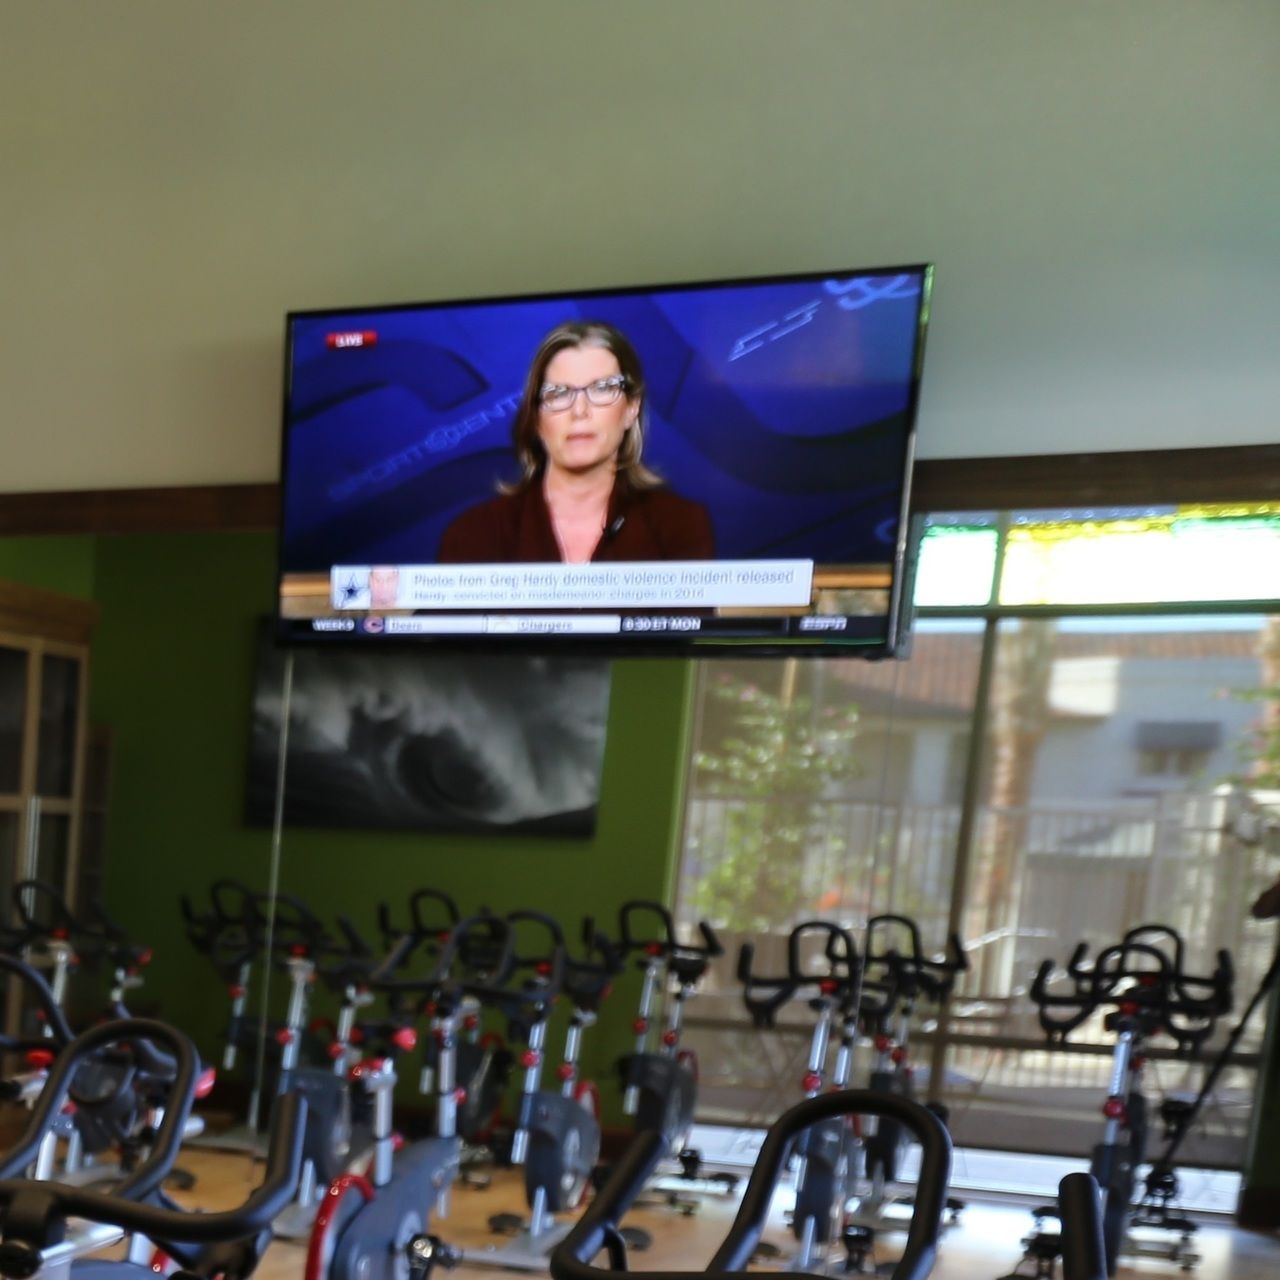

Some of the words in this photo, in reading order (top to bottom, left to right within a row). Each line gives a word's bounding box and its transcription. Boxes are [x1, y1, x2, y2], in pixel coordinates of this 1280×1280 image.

[335, 334, 364, 348] LIVE
[414, 573, 455, 587] Photos
[459, 573, 486, 586] from
[490, 573, 518, 589] Greg
[523, 572, 559, 589] Hardy
[563, 571, 619, 586] domestic
[624, 571, 677, 586] violence
[681, 569, 733, 585] incident
[736, 568, 795, 584] released
[670, 618, 701, 631] MON
[799, 616, 848, 631] ESPN
